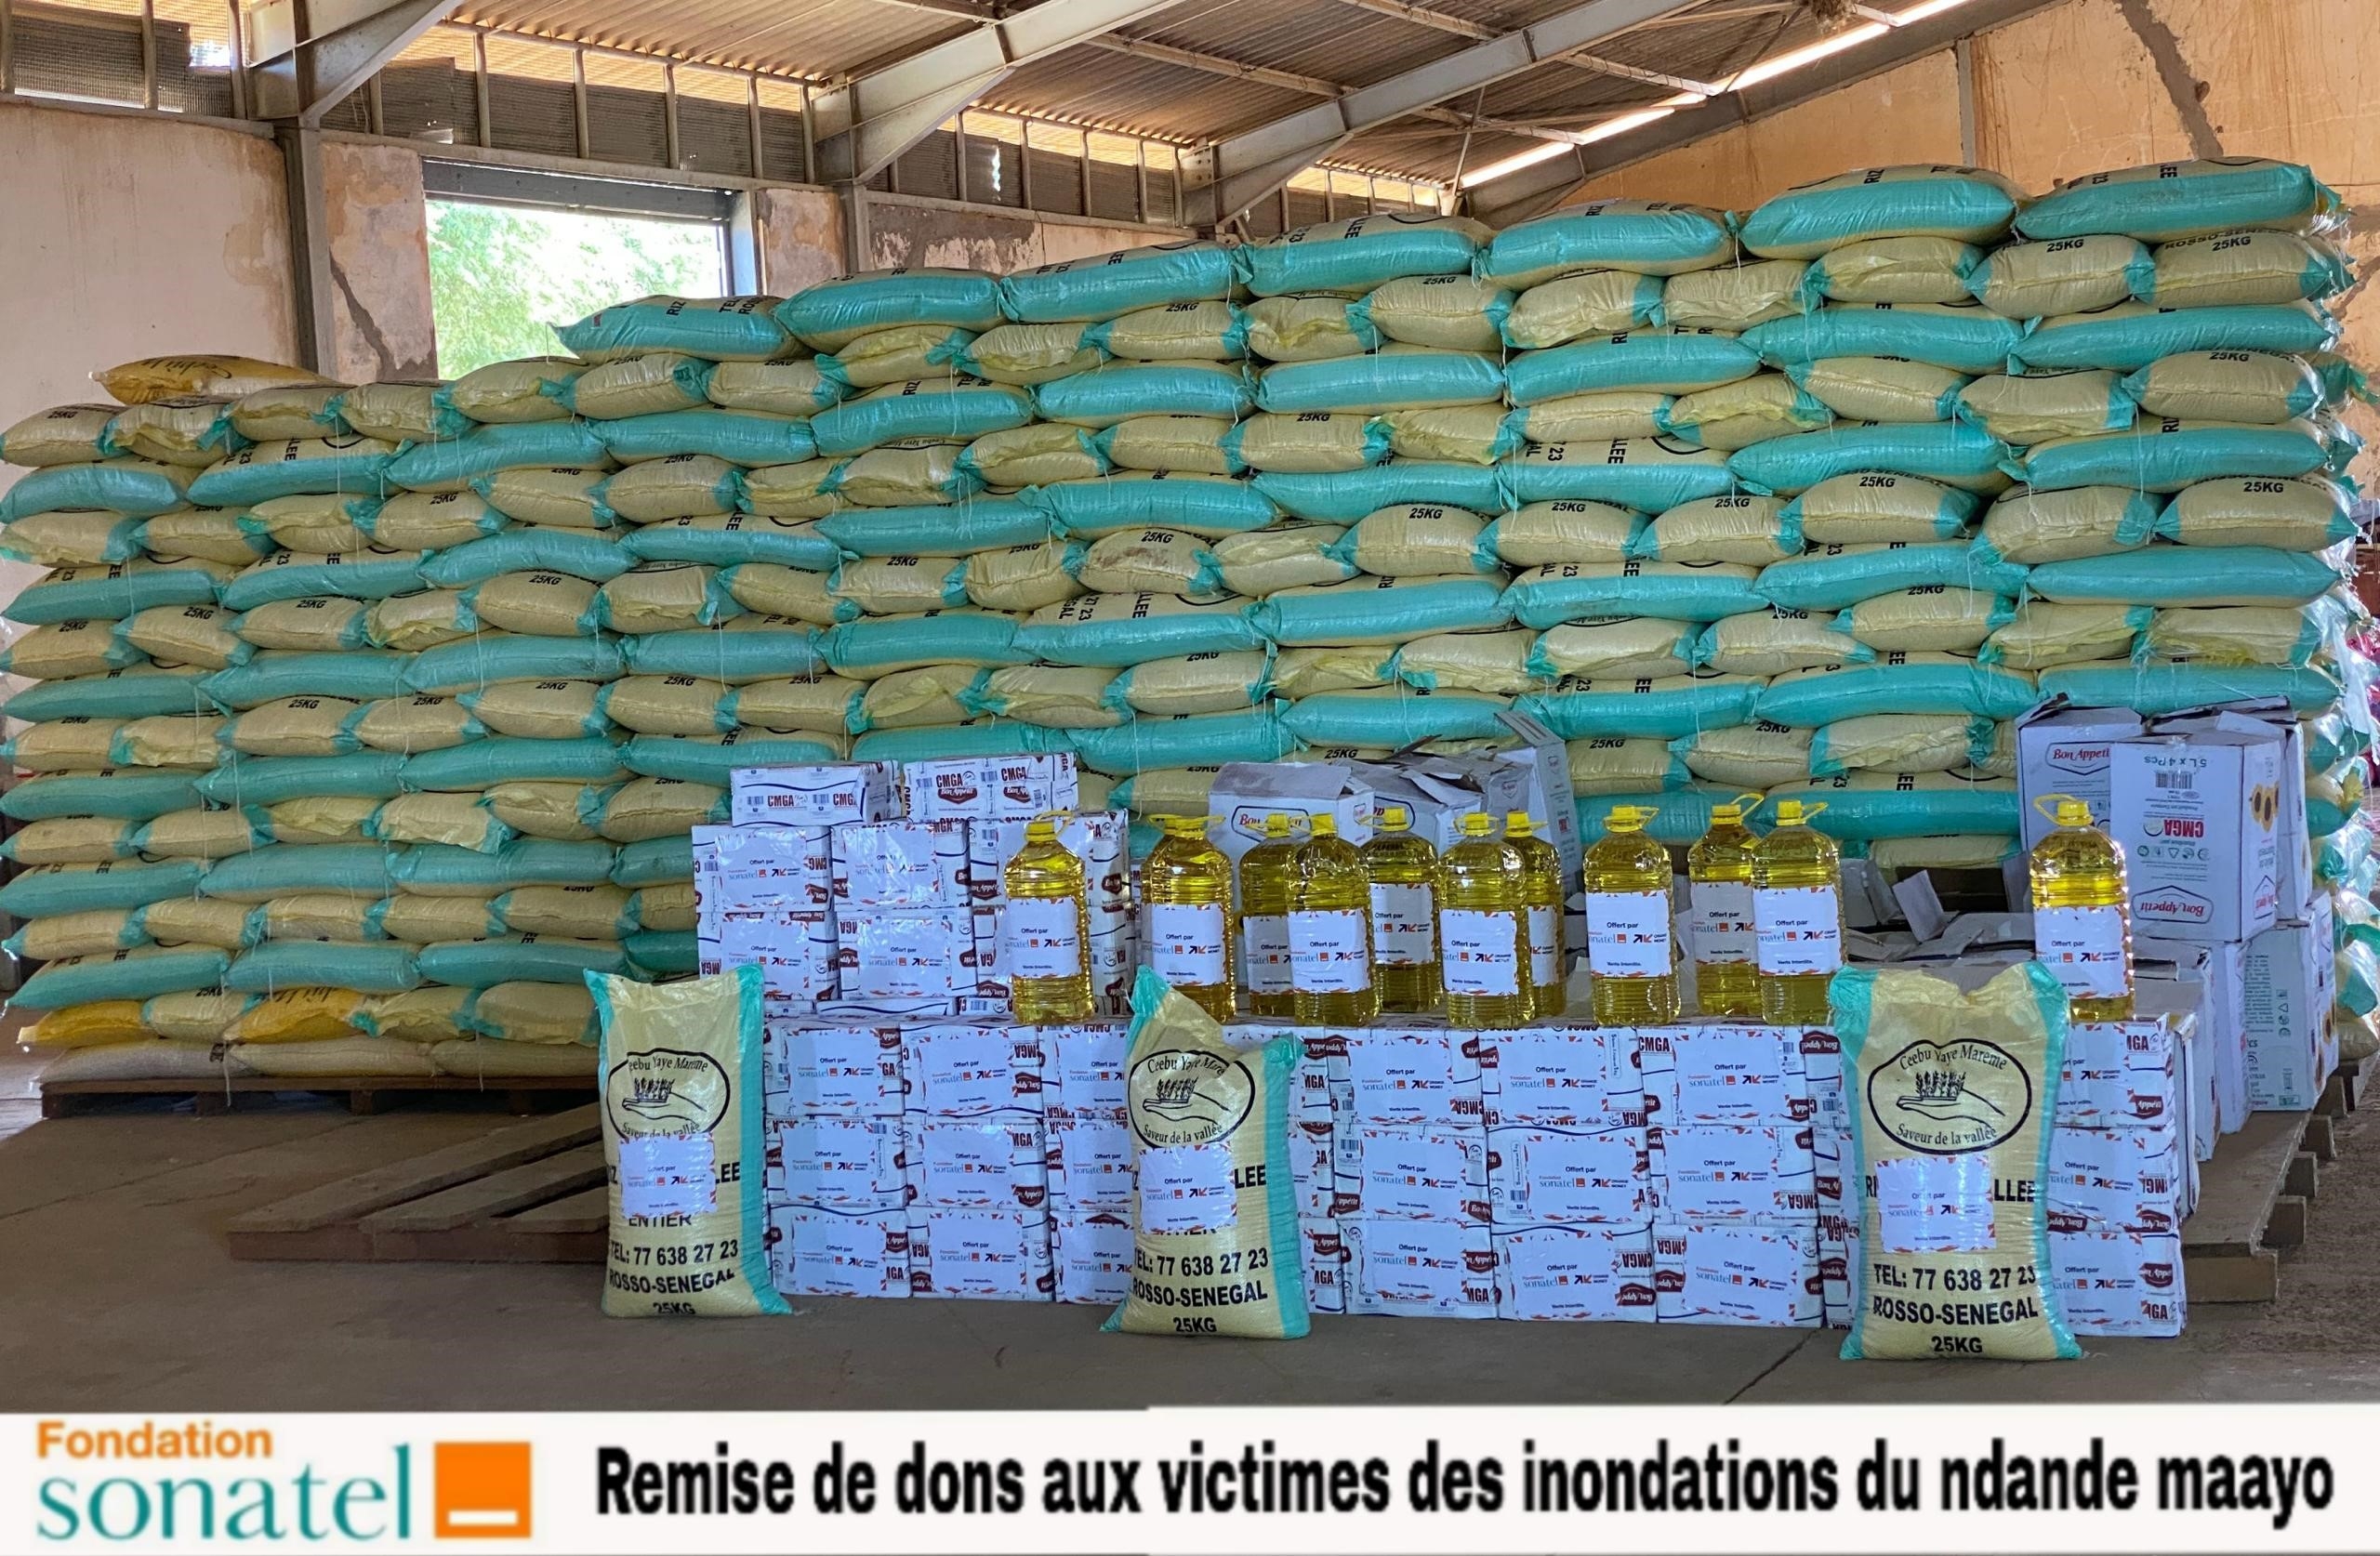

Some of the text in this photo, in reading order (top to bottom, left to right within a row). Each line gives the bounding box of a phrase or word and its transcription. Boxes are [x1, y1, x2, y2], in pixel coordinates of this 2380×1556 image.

[2046, 239, 2084, 253] 25KG
[2212, 236, 2251, 252] 25KG
[1422, 276, 1456, 285] 25KG
[1166, 303, 1197, 312] 25KG
[2209, 350, 2250, 363] 25KG
[47, 410, 77, 418] 25KG
[1297, 413, 1330, 422] 25KG
[1859, 476, 1896, 488] 25KG
[2243, 481, 2284, 494] 25KG
[430, 492, 457, 505] 25KG
[1714, 497, 1750, 508] 25KG
[1408, 508, 1443, 520] 25KG
[1551, 502, 1586, 513] 25KG
[1141, 531, 1174, 544] 25KG
[886, 557, 918, 567] 25KG
[529, 574, 562, 586] 25KG
[1907, 585, 1944, 596] 25KG
[296, 599, 326, 609] 25KG
[183, 606, 214, 620] 25KG
[1771, 609, 1808, 620] 25KG
[59, 620, 87, 632] 25KG
[536, 681, 568, 692] 25KG
[664, 677, 695, 687] 25KG
[789, 675, 822, 685] 25KG
[287, 698, 319, 710] 25KG
[413, 696, 443, 706] 25KG
[1590, 738, 1625, 749] 25KG
[1324, 748, 1358, 758] 25KG
[936, 773, 963, 787] CMGA
[1001, 767, 1027, 781] CMGA
[767, 795, 794, 807] CMGA
[2164, 820, 2204, 837] CMGA
[2182, 903, 2204, 916] Bon
[1639, 1036, 1670, 1052] CMGA
[628, 1058, 651, 1071] eebu
[1899, 1049, 1931, 1071] Ceebu
[1960, 1045, 2007, 1070] Mareme
[1144, 1125, 1169, 1143] Saveur
[1170, 1131, 1181, 1143] de
[1183, 1131, 1192, 1142] la
[1896, 1123, 1931, 1144] Saveur
[1935, 1131, 1948, 1145] de
[1952, 1130, 1961, 1144] la
[1235, 1166, 1266, 1189] LEE
[1994, 1179, 2036, 1203] LLEE
[612, 1239, 738, 1265] TEL: 77 638 27 23
[1157, 1256, 1175, 1275] 77
[1182, 1255, 1213, 1276] 638
[1220, 1252, 1241, 1274] 27
[1248, 1247, 1268, 1270] 23
[1621, 1253, 1652, 1268] CMGA
[609, 1269, 734, 1293] ROSSO-SENEGAL
[1873, 1263, 2036, 1291] TEL: 77 638 27 23
[1132, 1277, 1268, 1307] ROSSO-SENEGAL
[653, 1302, 695, 1315] 25KG
[1873, 1295, 2038, 1325] ROSSO-SENEGAL
[1173, 1317, 1217, 1333] 25KG
[1931, 1336, 1982, 1353] 25KG
